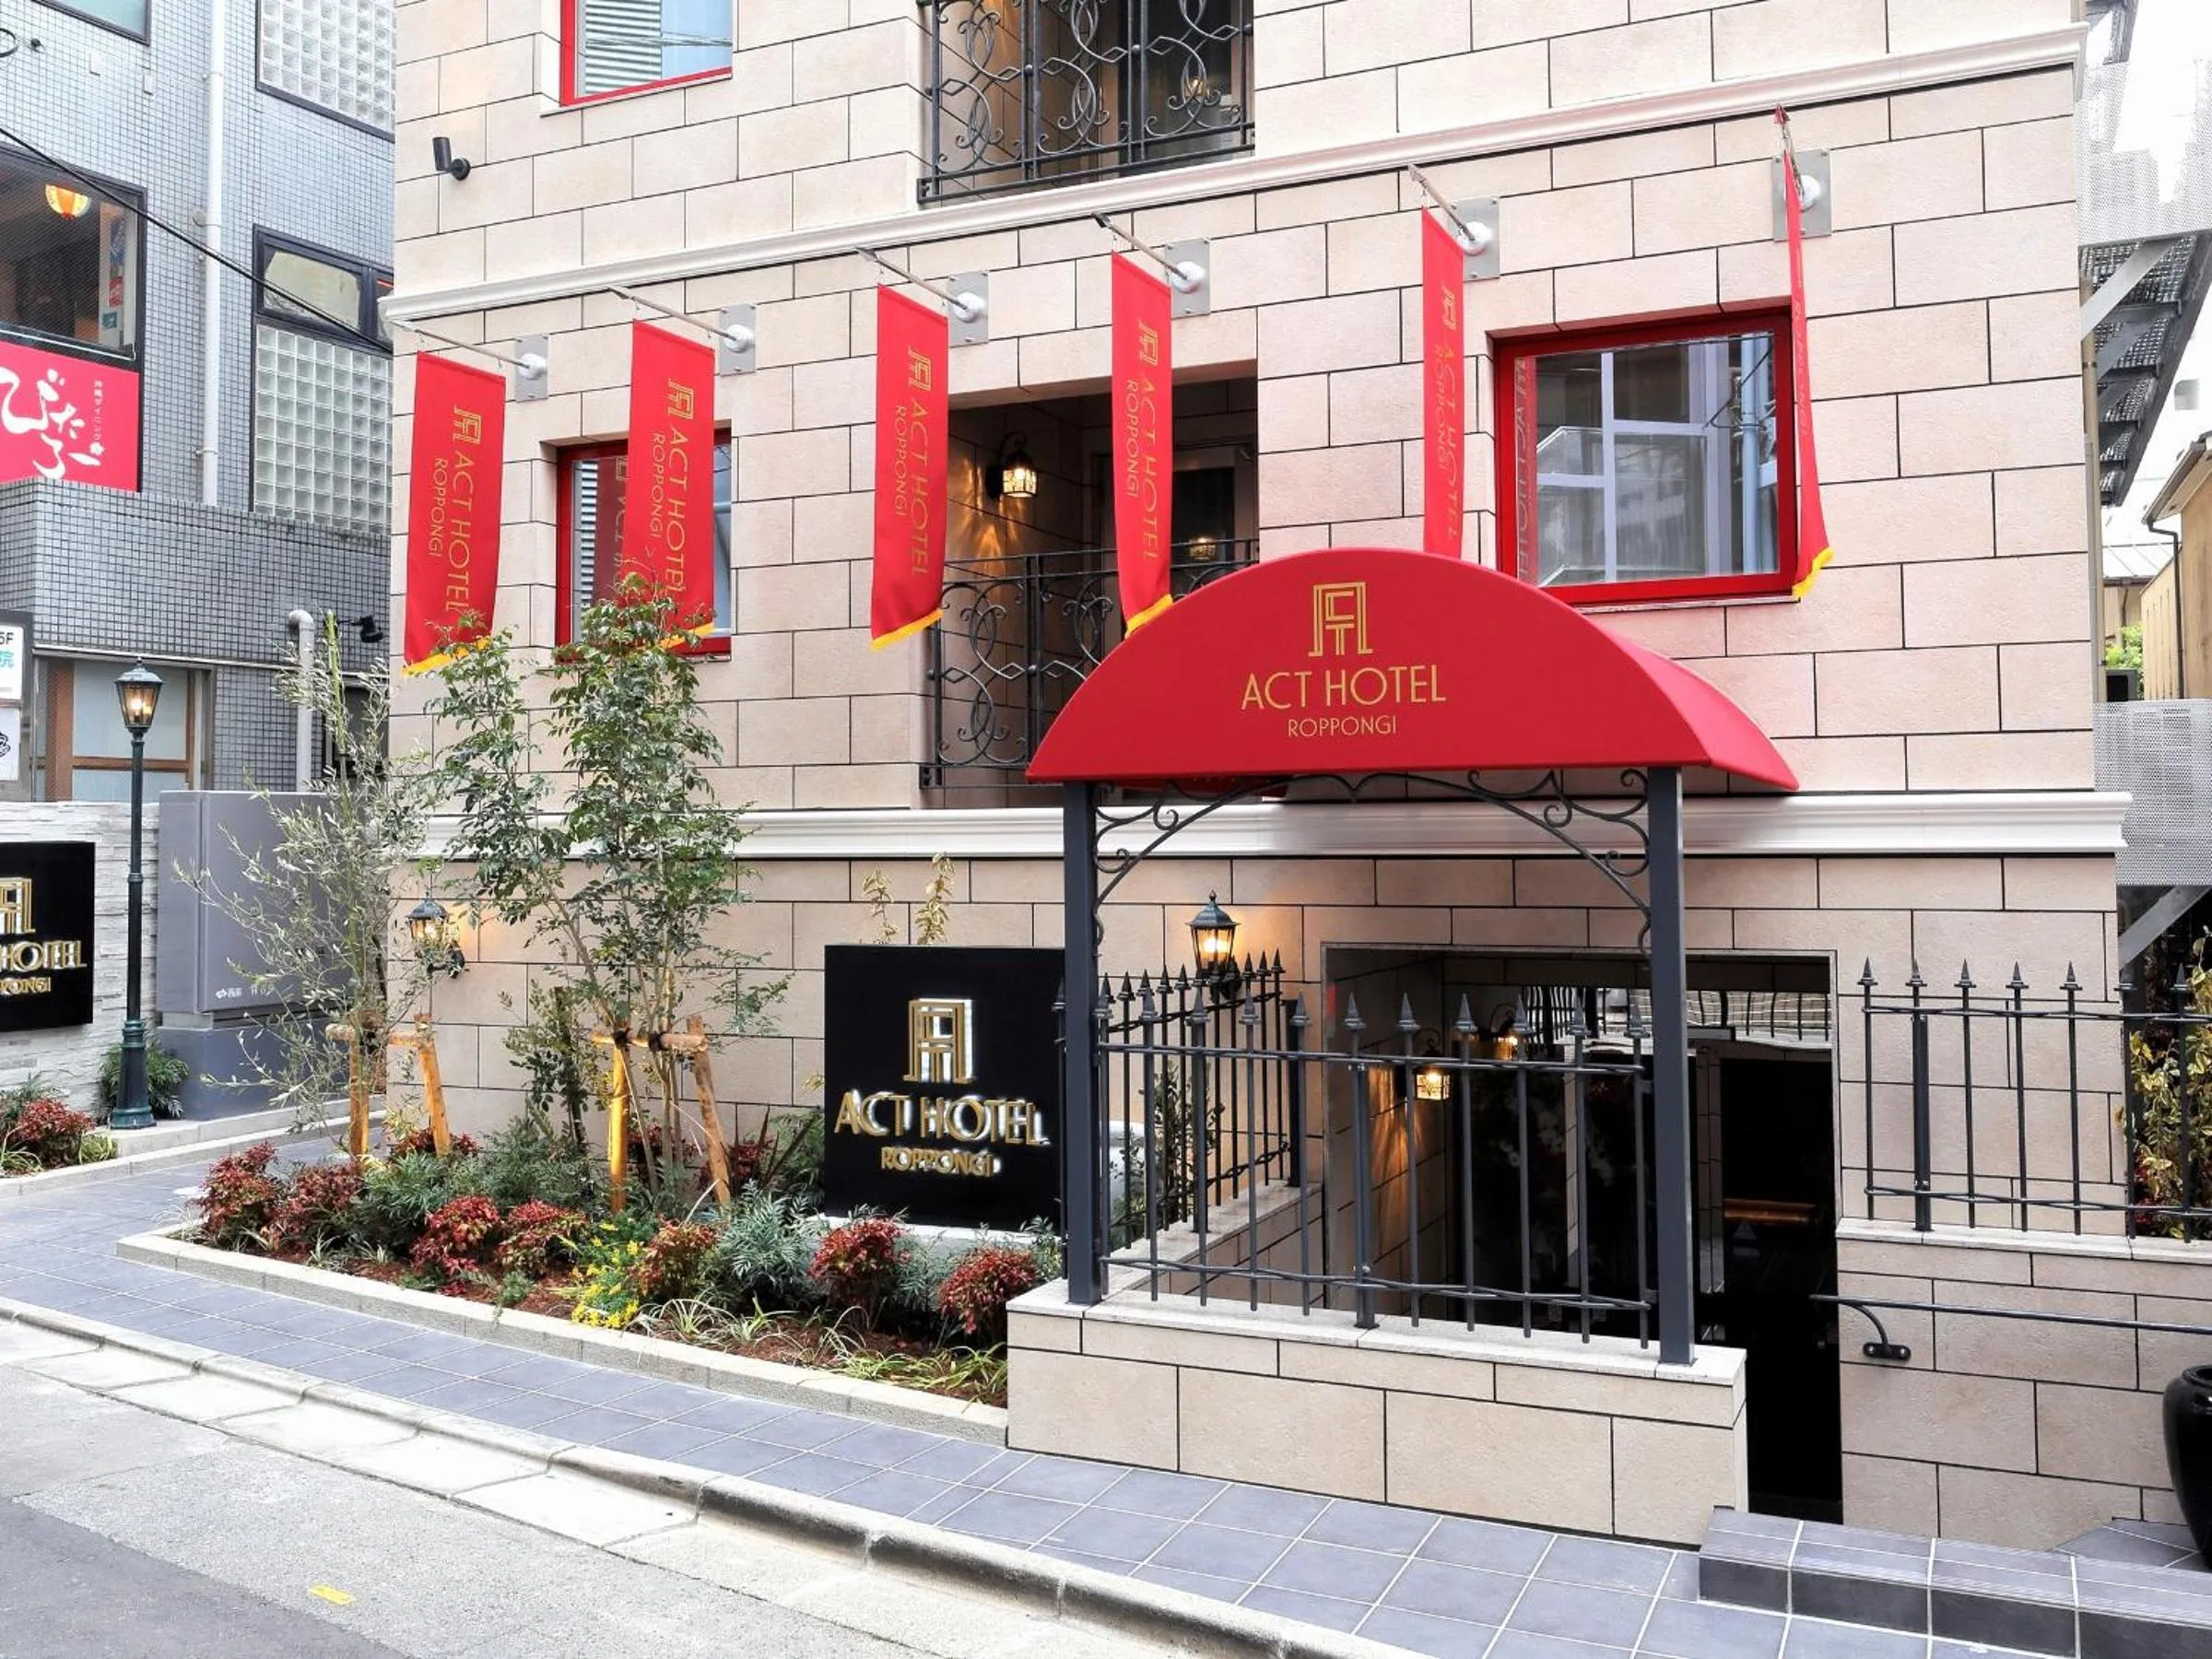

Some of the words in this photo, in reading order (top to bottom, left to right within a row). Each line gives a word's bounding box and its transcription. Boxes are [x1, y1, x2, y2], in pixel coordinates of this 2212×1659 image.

[910, 397, 929, 465] ACT
[1125, 380, 1140, 499] ROPPONGI
[1141, 375, 1157, 444] ACT
[453, 450, 476, 511] ACT
[652, 433, 665, 538] ROPPONGI
[666, 427, 689, 491] ACT
[893, 405, 909, 516] ROPPONGI
[429, 459, 449, 557] ROPPONGI
[910, 476, 930, 575] HOTEL
[1143, 455, 1159, 561] HOTEL
[445, 519, 471, 613] HOTEL
[664, 499, 687, 599] HOTEL
[1241, 670, 1312, 710] ACT
[1325, 664, 1447, 707] HOTEL
[1288, 714, 1396, 737] ROPPONGI
[834, 1089, 912, 1137] ACT
[919, 1095, 1052, 1147] HOTEL
[880, 1146, 1002, 1178] ROPPONGI
